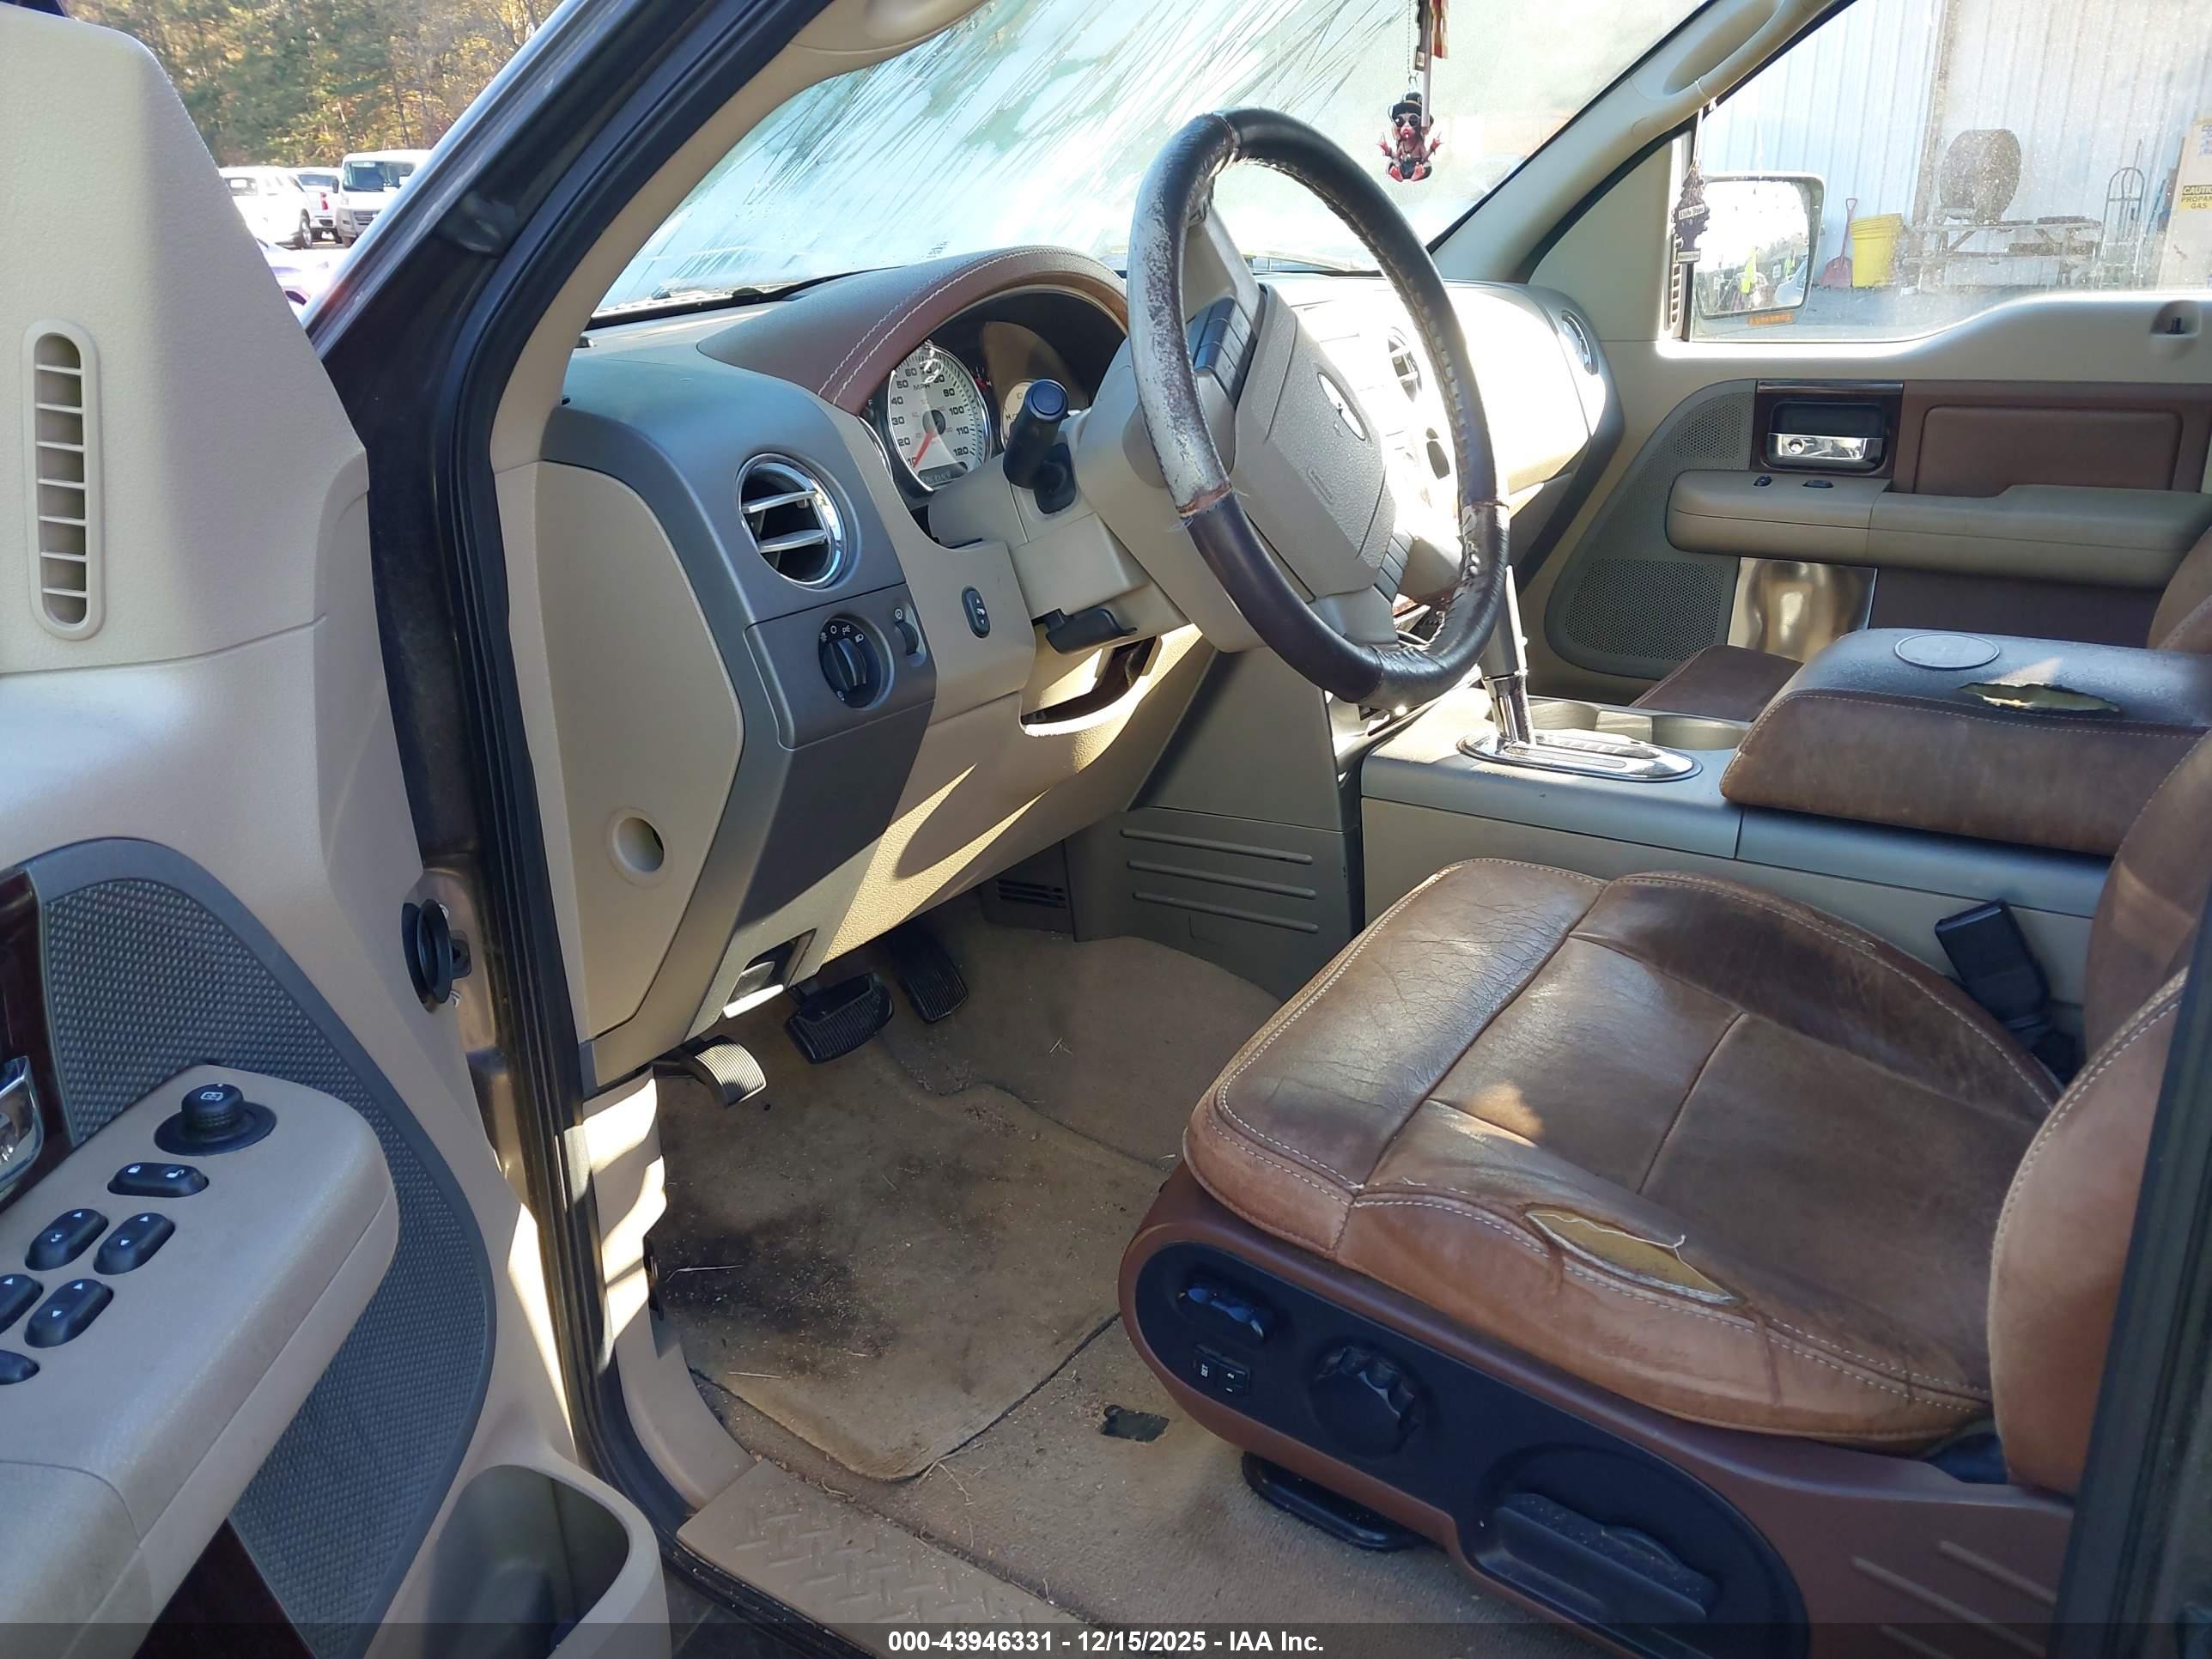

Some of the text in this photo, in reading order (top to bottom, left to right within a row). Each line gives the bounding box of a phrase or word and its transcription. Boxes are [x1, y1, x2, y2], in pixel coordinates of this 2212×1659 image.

[905, 368, 917, 377] 60
[896, 380, 908, 389] 50
[891, 396, 903, 405] 40
[949, 405, 964, 416] 100
[892, 416, 905, 425] 30
[956, 426, 969, 435] 110
[898, 437, 911, 447] 20
[953, 447, 969, 457] 120
